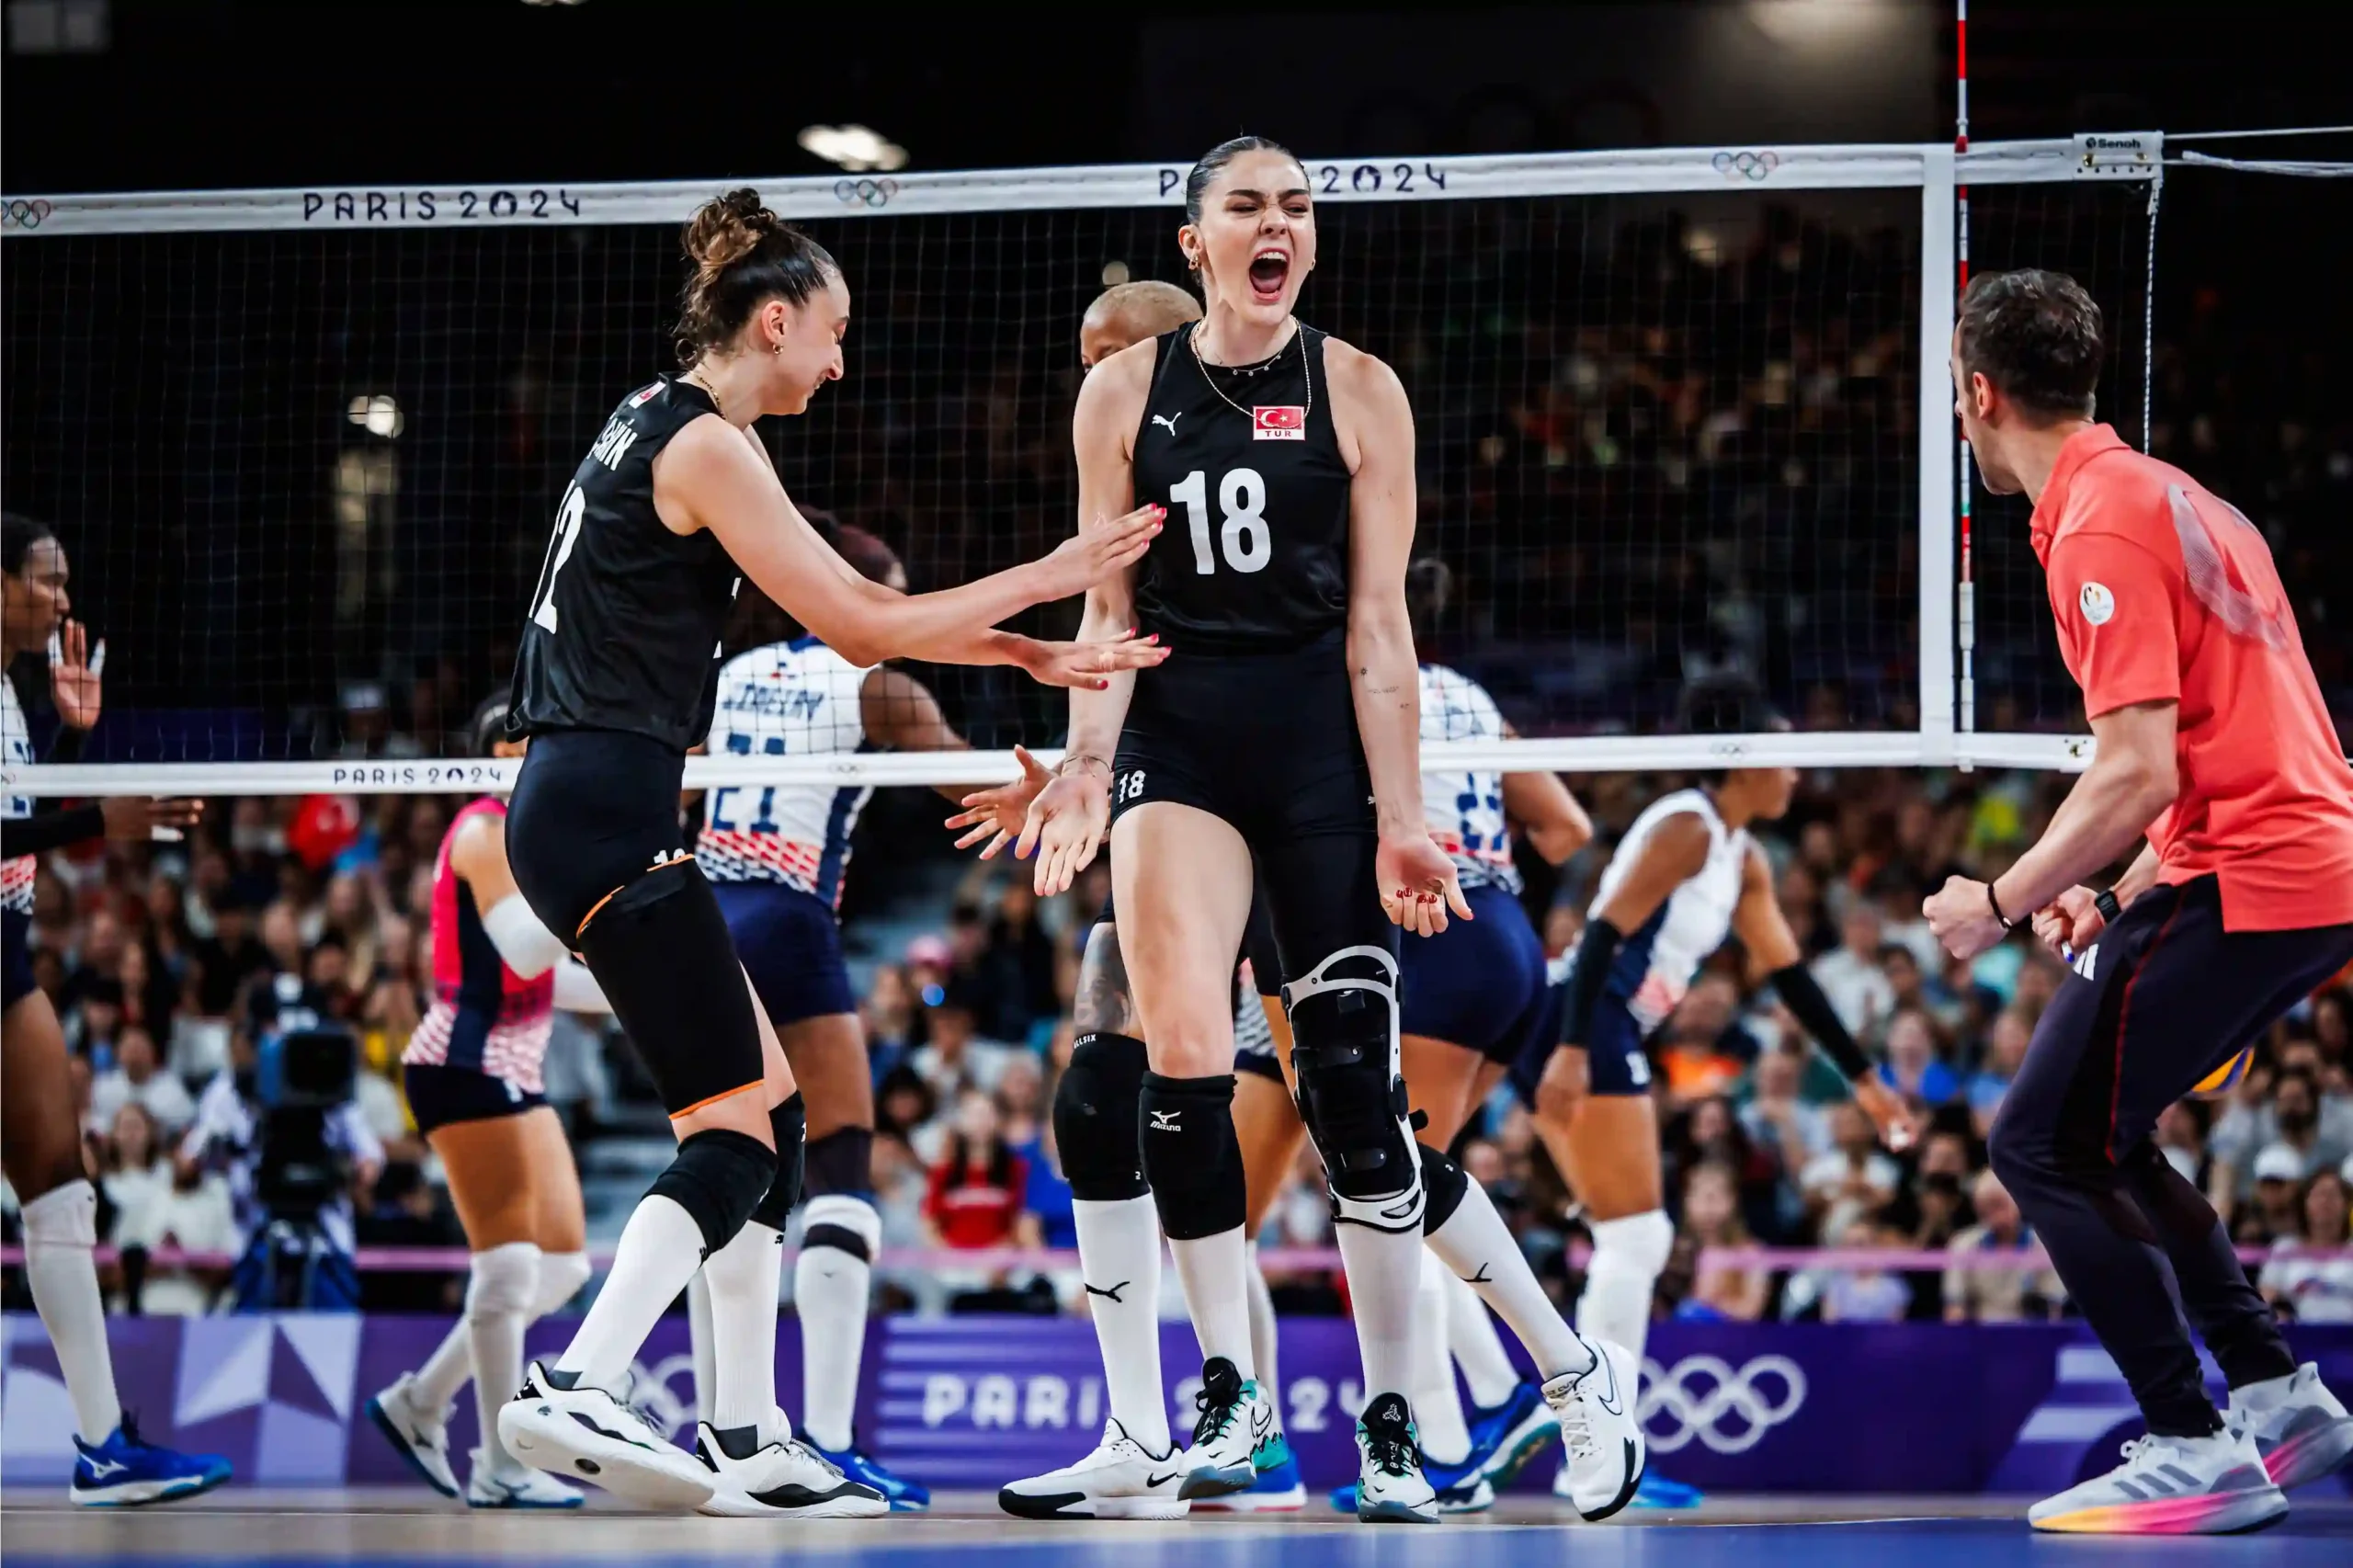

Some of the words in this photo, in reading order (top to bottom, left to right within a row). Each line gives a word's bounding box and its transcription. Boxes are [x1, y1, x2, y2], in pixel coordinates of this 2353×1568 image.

[2097, 138, 2141, 148] Senoh
[303, 191, 437, 222] PARIS
[459, 188, 580, 219] 2024
[1169, 467, 1272, 575] 18
[334, 768, 415, 785] PARIS
[427, 767, 502, 784] 2024
[1119, 769, 1147, 804] 18
[1134, 1170, 1142, 1180] 2
[922, 1373, 1103, 1431] PARI
